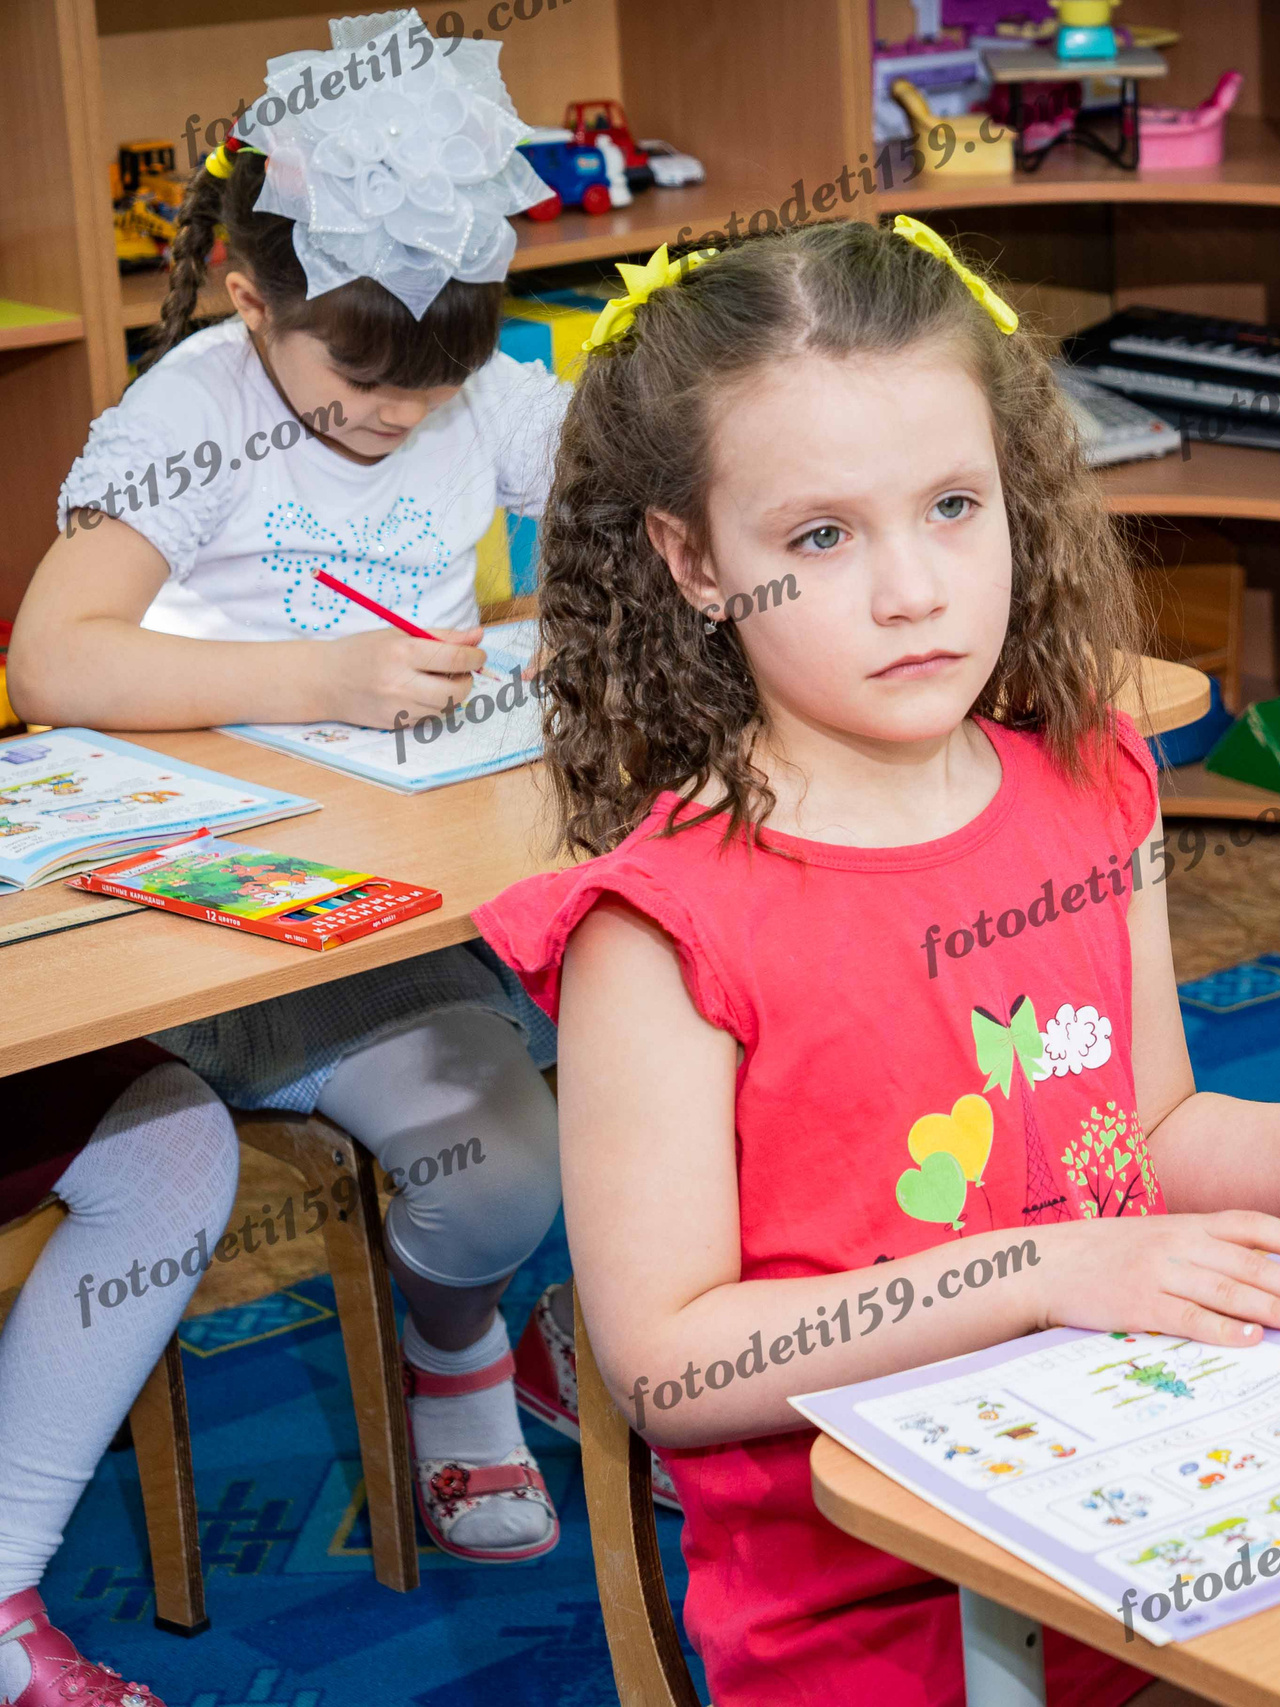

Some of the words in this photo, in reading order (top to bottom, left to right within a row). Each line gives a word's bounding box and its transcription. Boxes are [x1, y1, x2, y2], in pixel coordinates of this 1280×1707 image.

[102, 884, 128, 897] ЦВЕТНЫЕ
[129, 890, 165, 907] КАРАНДАШИ
[205, 910, 217, 921] 12
[218, 916, 241, 926] цветов
[312, 893, 396, 927] ЦВЕТНЫЕ
[313, 890, 424, 934] КАРАНДАШИ
